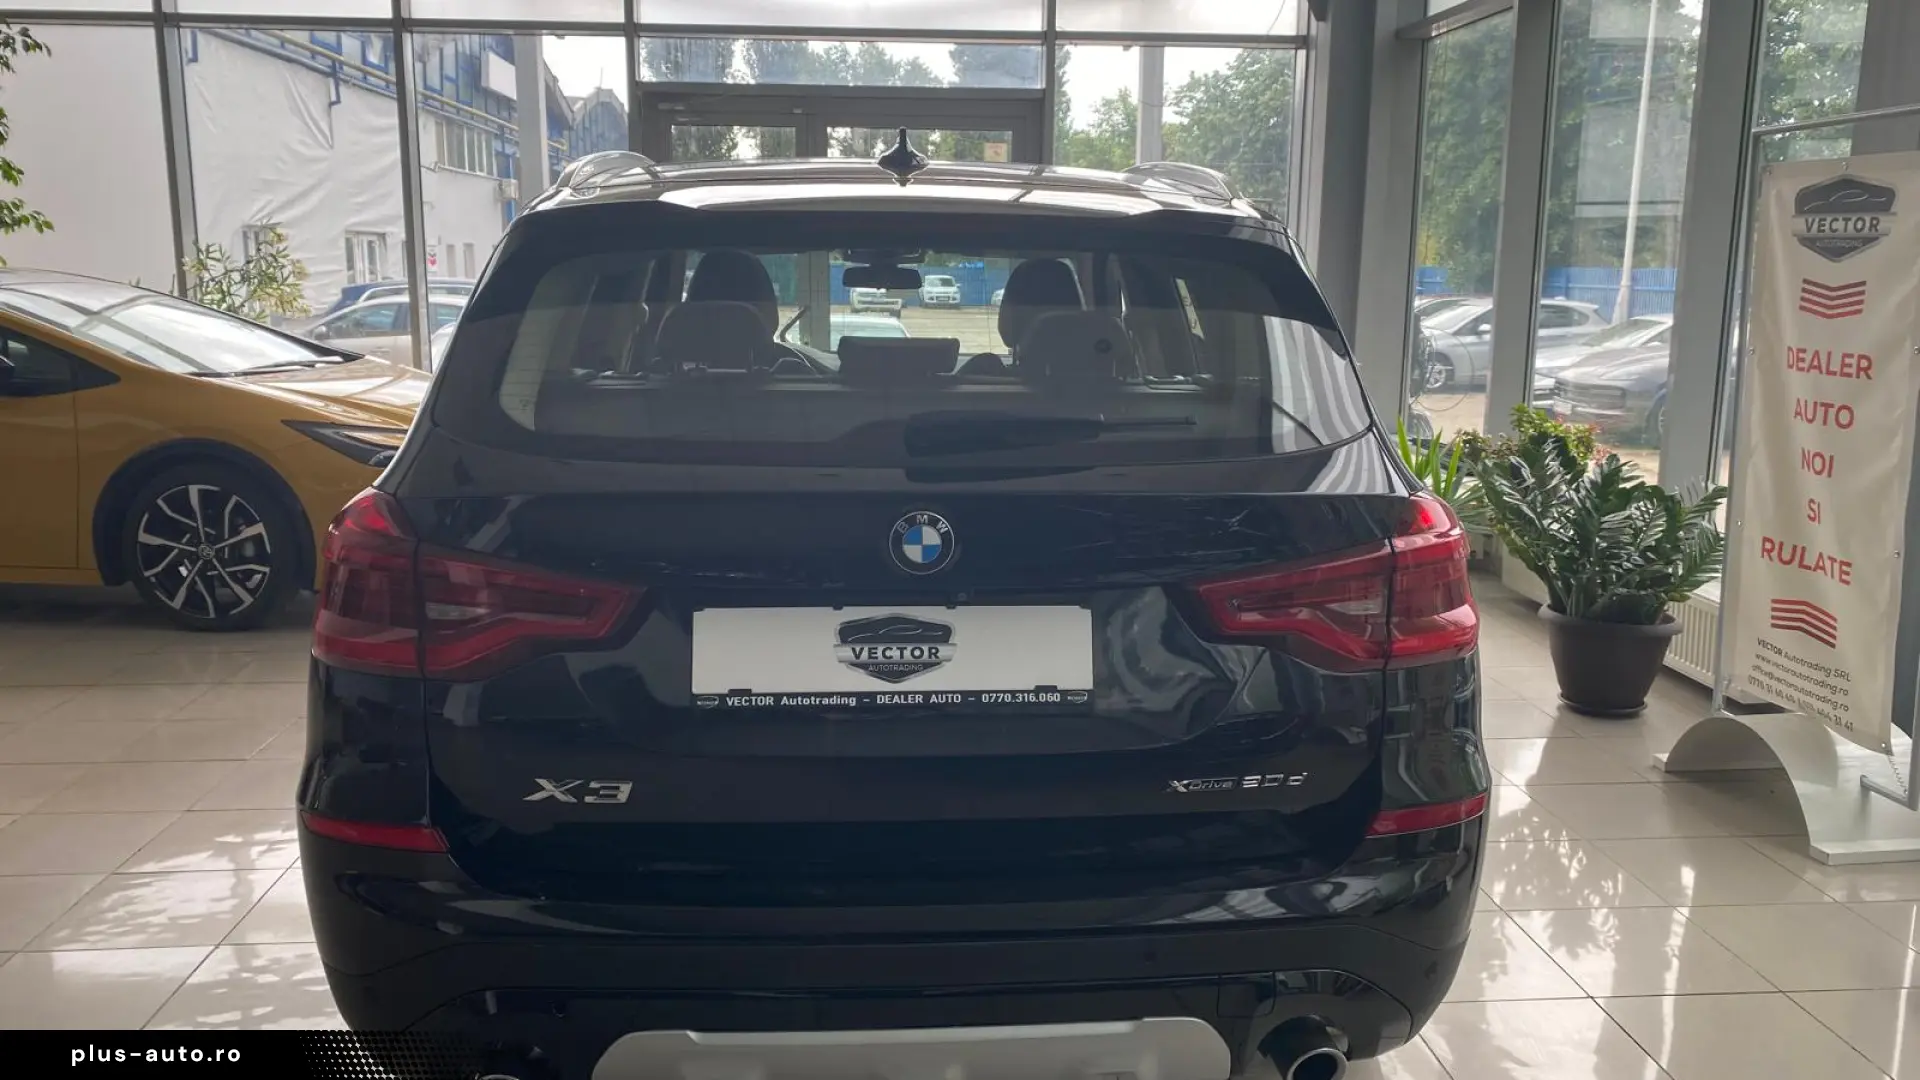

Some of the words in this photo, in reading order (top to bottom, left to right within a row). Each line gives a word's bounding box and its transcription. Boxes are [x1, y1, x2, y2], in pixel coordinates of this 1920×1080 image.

[1804, 216, 1881, 233] VECTOR
[1786, 345, 1873, 380] DEALER
[1793, 397, 1855, 430] AUTO
[1801, 446, 1835, 478] NOI
[1806, 498, 1821, 524] SI
[1760, 535, 1853, 586] RULATE
[851, 646, 941, 661] VECTOR
[1757, 637, 1783, 658] VECTOR
[1784, 651, 1832, 678] Autotrading
[1834, 669, 1852, 682] SRL
[868, 664, 924, 672] AUTOTRADING
[726, 696, 774, 706] VECTOR
[780, 695, 857, 706] Autotrading
[876, 694, 924, 704] DEALER
[929, 693, 962, 704] AUTO
[981, 692, 1061, 703] 0770.316.060
[522, 778, 633, 803] X3
